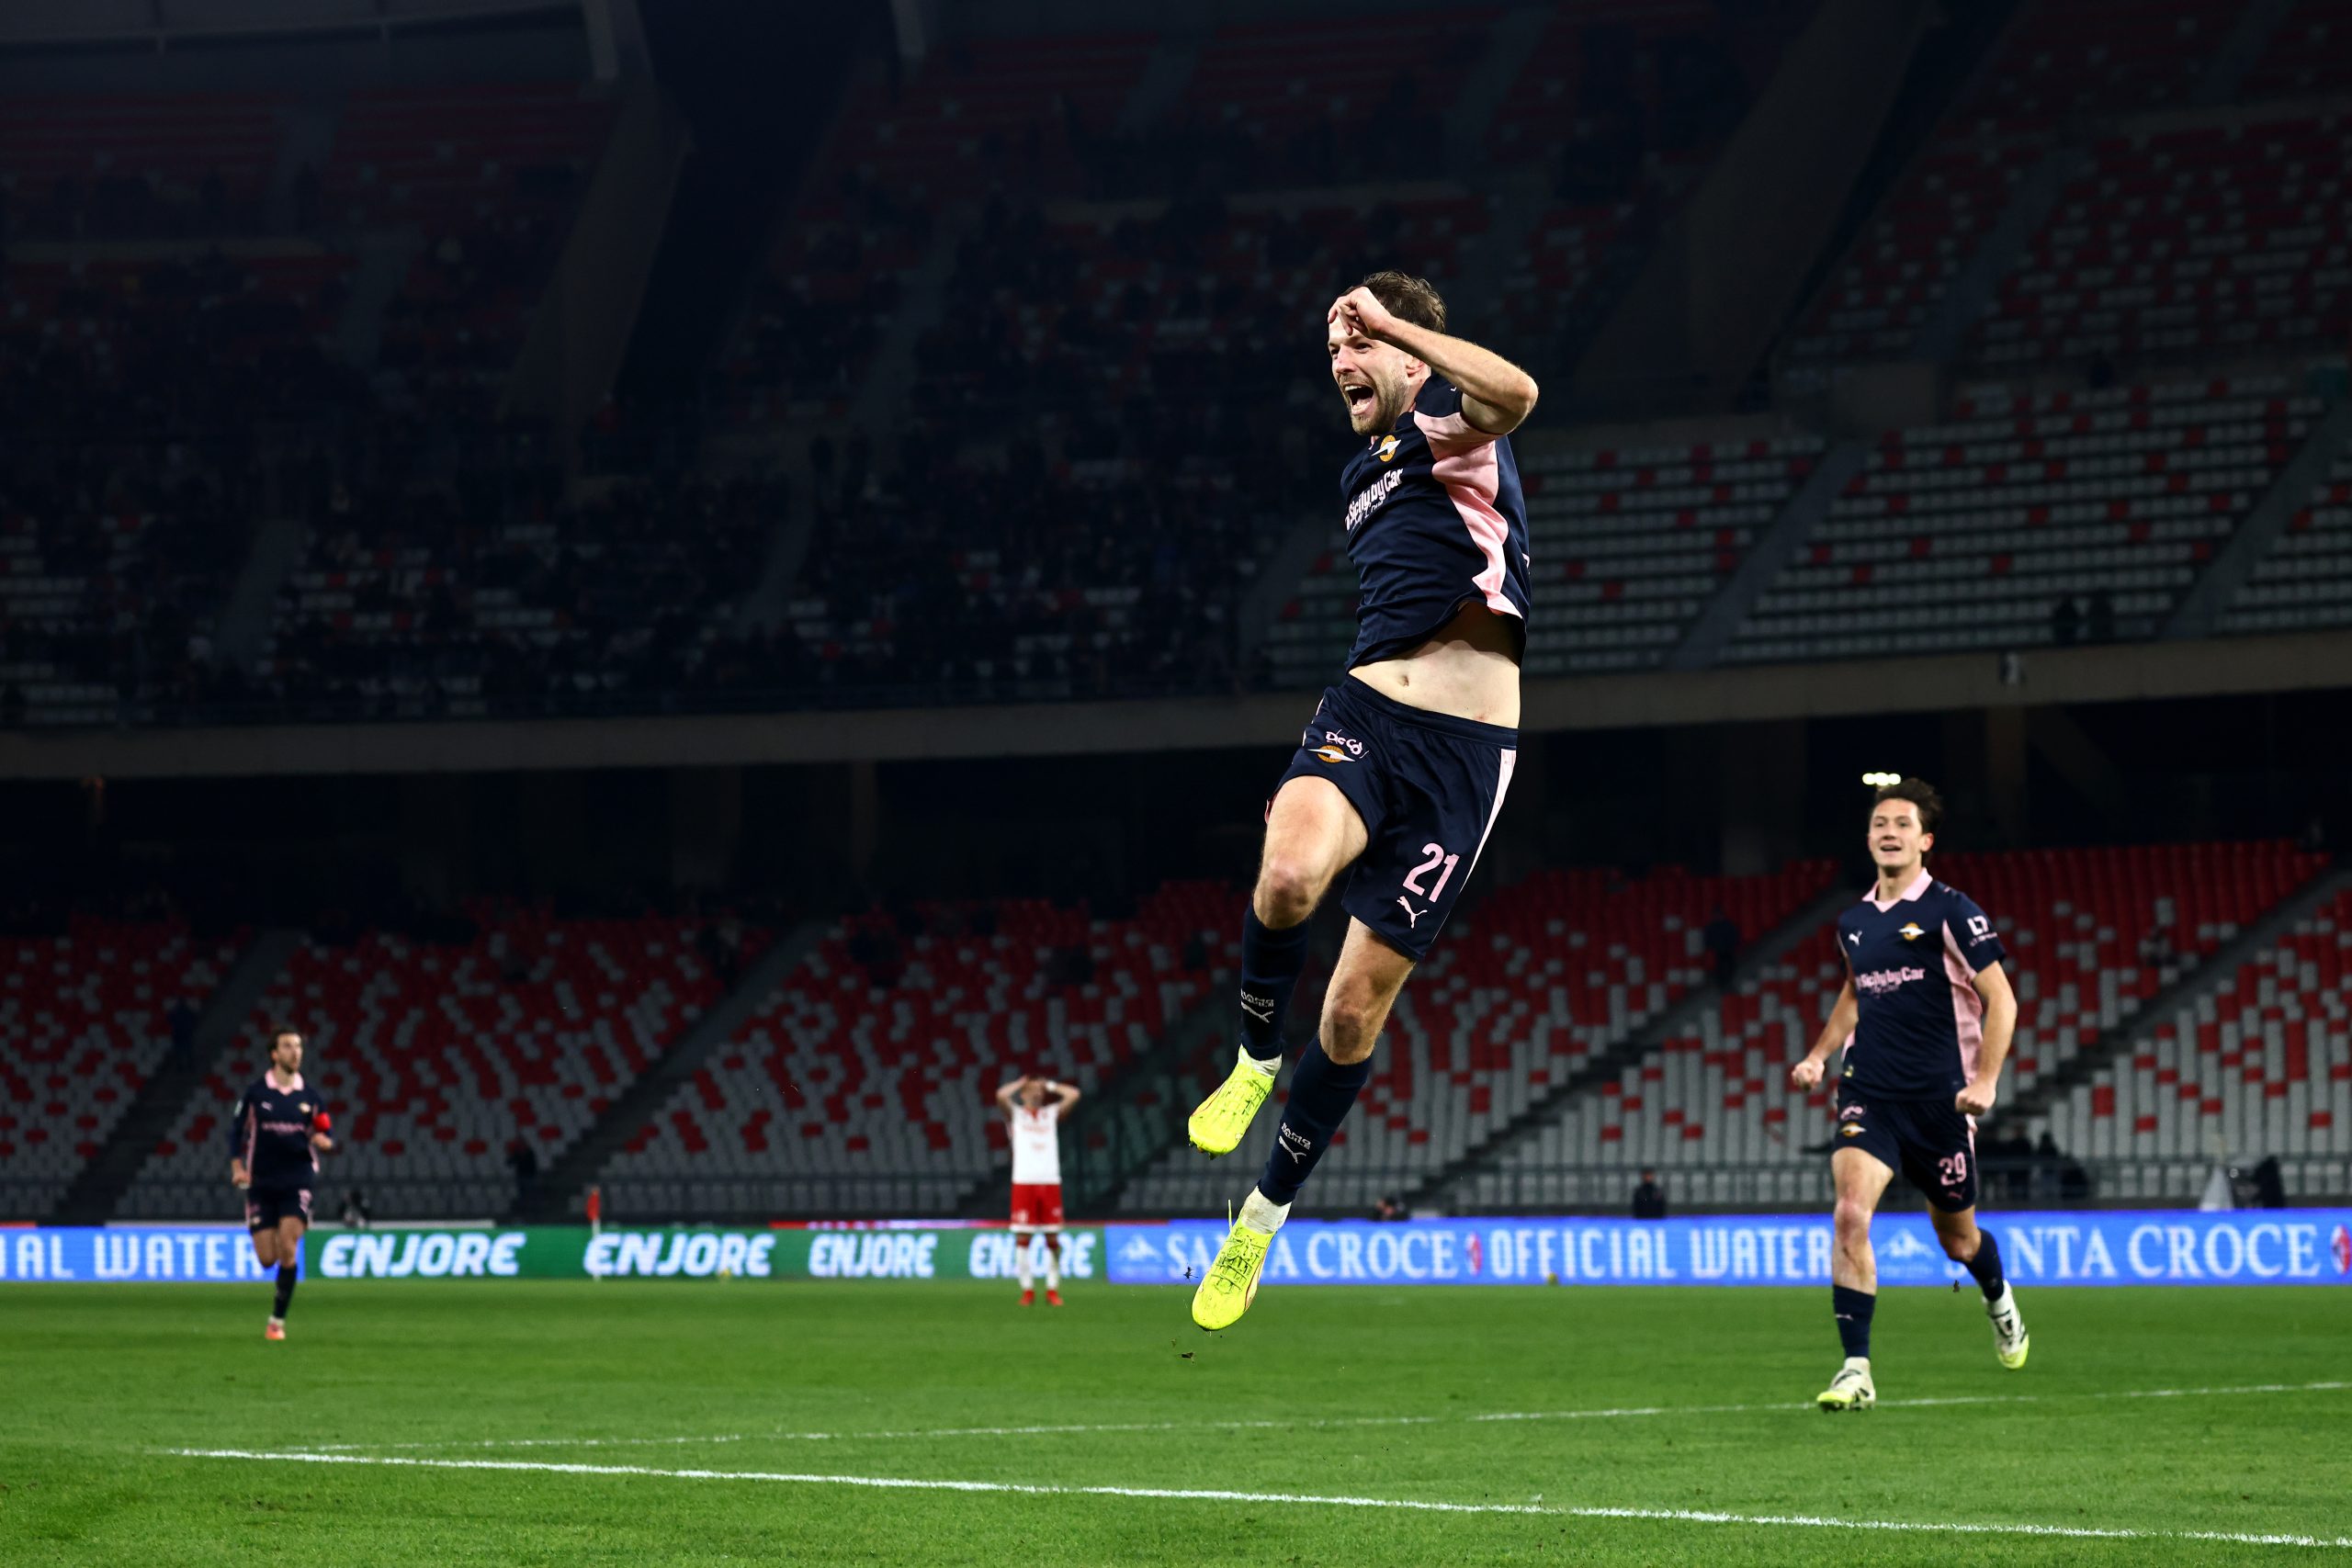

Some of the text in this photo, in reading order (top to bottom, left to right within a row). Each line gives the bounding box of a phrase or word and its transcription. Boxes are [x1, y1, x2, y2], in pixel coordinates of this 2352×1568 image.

[1403, 842, 1460, 903] 21
[1939, 1151, 1966, 1186] 29
[94, 1235, 264, 1278] WATER
[320, 1233, 526, 1278] ENJORE
[583, 1233, 775, 1277] ENJORE
[808, 1233, 938, 1278] ENJORE
[968, 1233, 1097, 1278] ENORE
[1166, 1231, 1459, 1279] SAA CROCE
[1489, 1226, 1833, 1279] OFFICIAL WATER
[2127, 1224, 2321, 1278] CROCE
